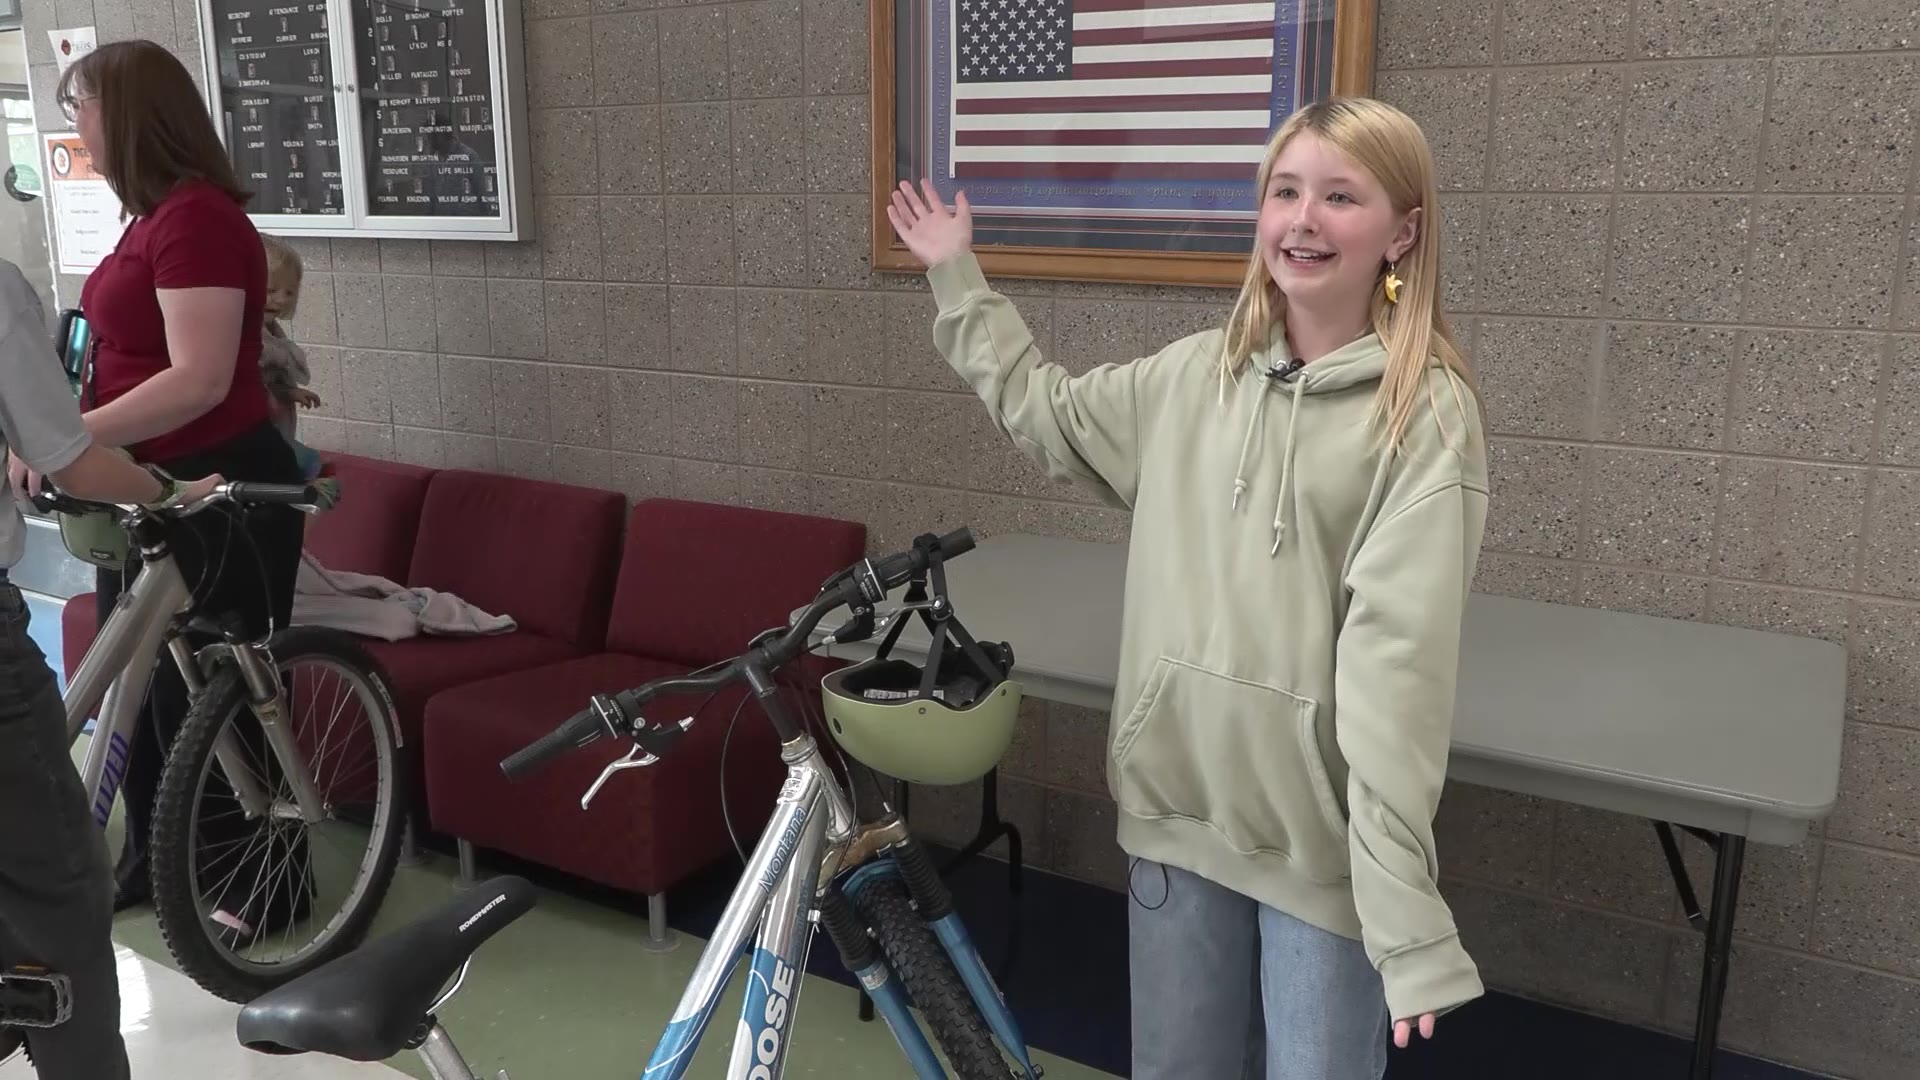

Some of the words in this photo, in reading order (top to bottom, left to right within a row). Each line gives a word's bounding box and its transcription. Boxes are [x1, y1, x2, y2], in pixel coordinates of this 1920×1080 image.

[405, 12, 430, 21] BINGHAM
[442, 8, 464, 17] PORTER
[368, 27, 374, 38] 2
[409, 42, 428, 50] LYNCH
[371, 56, 377, 66] 3
[380, 72, 402, 80] MILLER
[449, 68, 472, 77] WOODS
[303, 95, 323, 103] NURSE
[452, 94, 486, 104] JOHNSTON
[376, 110, 382, 120] 5
[382, 167, 409, 175] RESOURCE
[438, 167, 452, 175] LIFE
[758, 806, 807, 894] Montana
